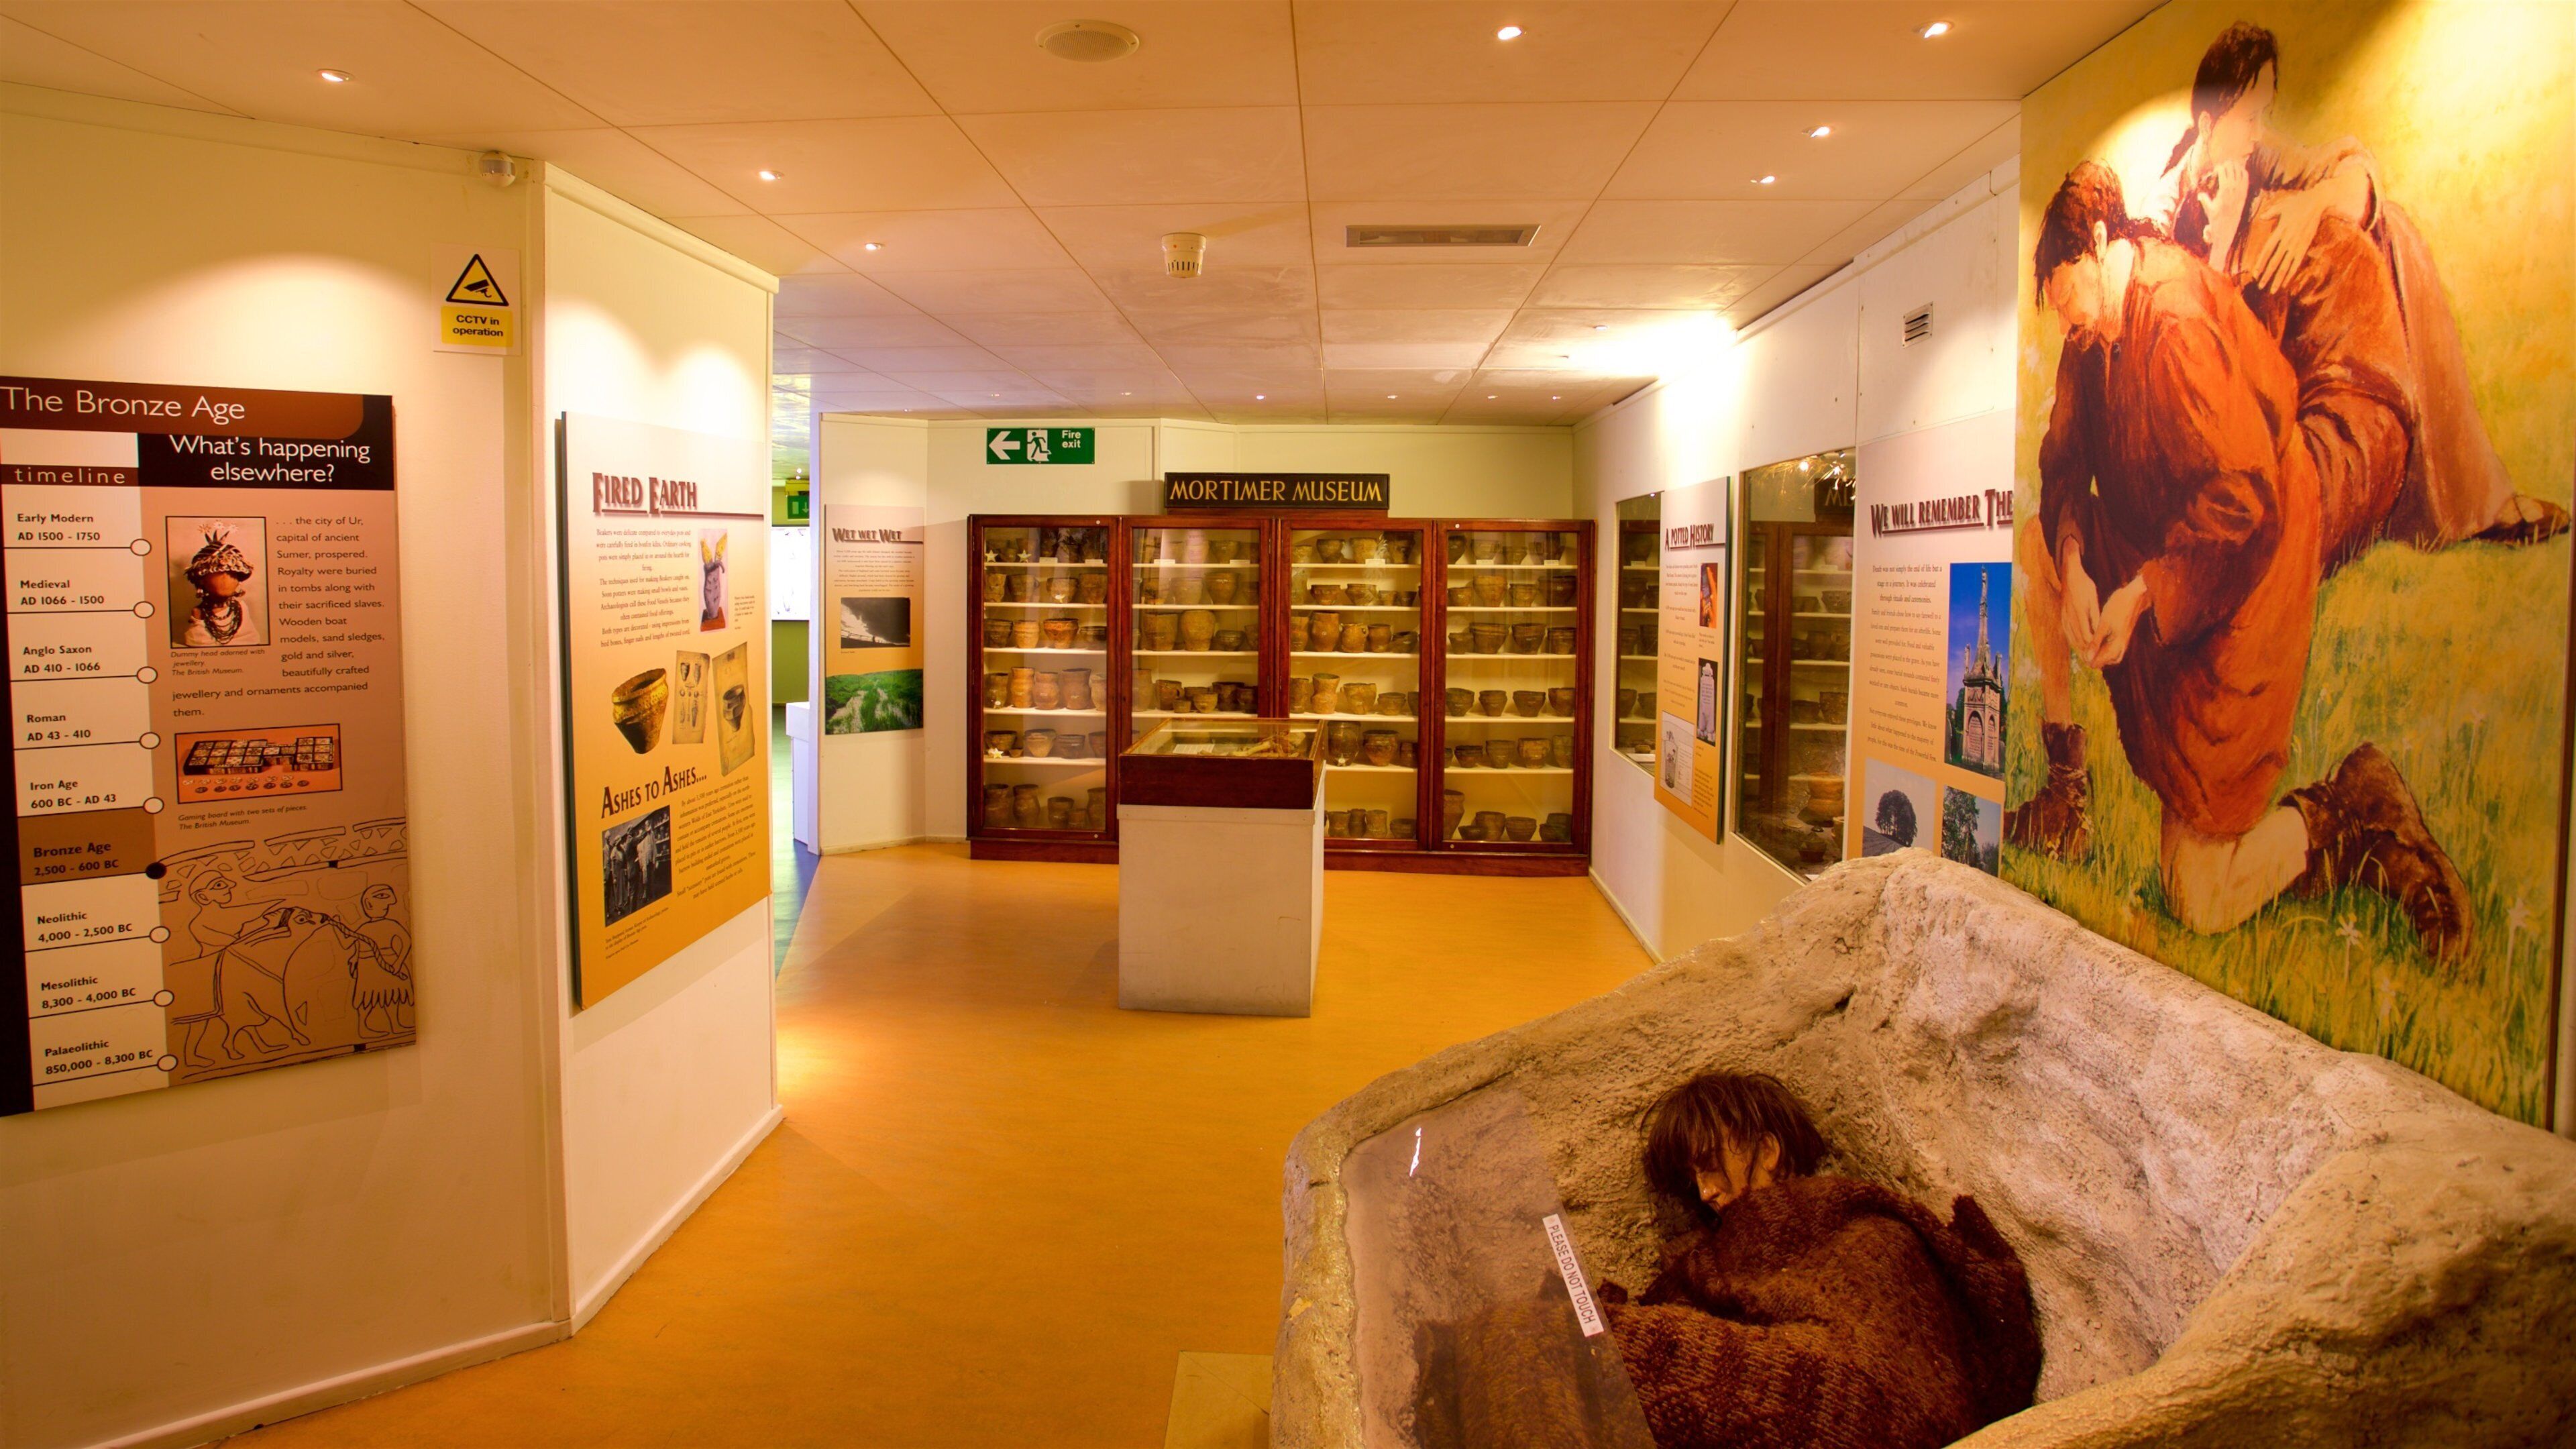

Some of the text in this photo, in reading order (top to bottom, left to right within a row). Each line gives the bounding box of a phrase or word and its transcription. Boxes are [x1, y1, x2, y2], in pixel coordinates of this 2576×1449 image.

[456, 315, 500, 325] CCTV in
[453, 327, 504, 337] operation
[0, 386, 245, 425] The Bronze Age
[1062, 430, 1081, 439] Fire
[169, 435, 371, 464] What's happening
[1062, 439, 1081, 448] exit
[15, 467, 125, 484] timeline
[211, 462, 335, 482] elsewhere?
[592, 472, 697, 514] FIRED EARTH
[1169, 480, 1383, 502] MORTIMER MUSEUM
[17, 513, 94, 524] Early Modern
[296, 517, 364, 526] the city of Ur,
[1870, 504, 1888, 537] WE
[1892, 503, 1915, 526] WILL
[1919, 494, 1980, 524] REMEMBER
[17, 532, 34, 541] AD
[38, 532, 64, 541] 1500
[76, 532, 101, 541] 1750
[276, 533, 360, 543] capital of ancient
[1665, 528, 1670, 551] A
[1690, 523, 1715, 549] HISTORY
[277, 550, 368, 560] Sumer, prospered.
[278, 568, 314, 577] Royalty
[346, 567, 377, 575] buried
[20, 580, 70, 588] Medieval
[278, 583, 375, 593] in tombs along with
[21, 596, 36, 605] AD
[41, 596, 66, 604] 1066
[80, 596, 105, 604] 1500
[279, 600, 384, 609] their sacrificed slaves.
[279, 617, 347, 626] Wooden boat
[280, 633, 385, 643] models, sand sledges,
[23, 645, 92, 657] Anglo Saxon
[281, 650, 354, 662] gold and silver,
[23, 665, 40, 674] AD
[44, 663, 62, 672] 410
[75, 662, 101, 672] 1066
[282, 665, 370, 677] beautifully crafted
[172, 682, 368, 701] jewellery and ornaments accompanied
[173, 708, 205, 716] them.
[27, 714, 66, 723] Roman
[28, 733, 43, 741] AD
[48, 731, 60, 740] 43
[73, 729, 91, 738] 410
[30, 780, 78, 790] Iron Age
[31, 799, 53, 808] 600
[58, 797, 72, 806] BC
[85, 795, 99, 804] AD
[104, 794, 116, 802] 43
[601, 786, 641, 818] ASHES
[645, 781, 659, 802] TO
[34, 843, 111, 858] Bronze Age
[34, 865, 66, 877] 2,500
[78, 861, 100, 871] 600
[105, 859, 119, 869] BC
[37, 912, 87, 924] Neolithic
[38, 931, 70, 943] 4,000
[84, 926, 114, 937] 2,500
[118, 924, 132, 932] BC
[41, 976, 98, 991] Mesolithic
[42, 997, 73, 1009] 8,300
[86, 991, 118, 1003] 4,000
[122, 988, 136, 998] BC
[45, 1040, 109, 1057] Palaeolithic
[46, 1059, 93, 1075] 850,000
[105, 1053, 135, 1065] 8,300
[139, 1049, 153, 1059] BC
[1549, 1224, 1596, 1324] PLEASE DO NOT TOUCH
